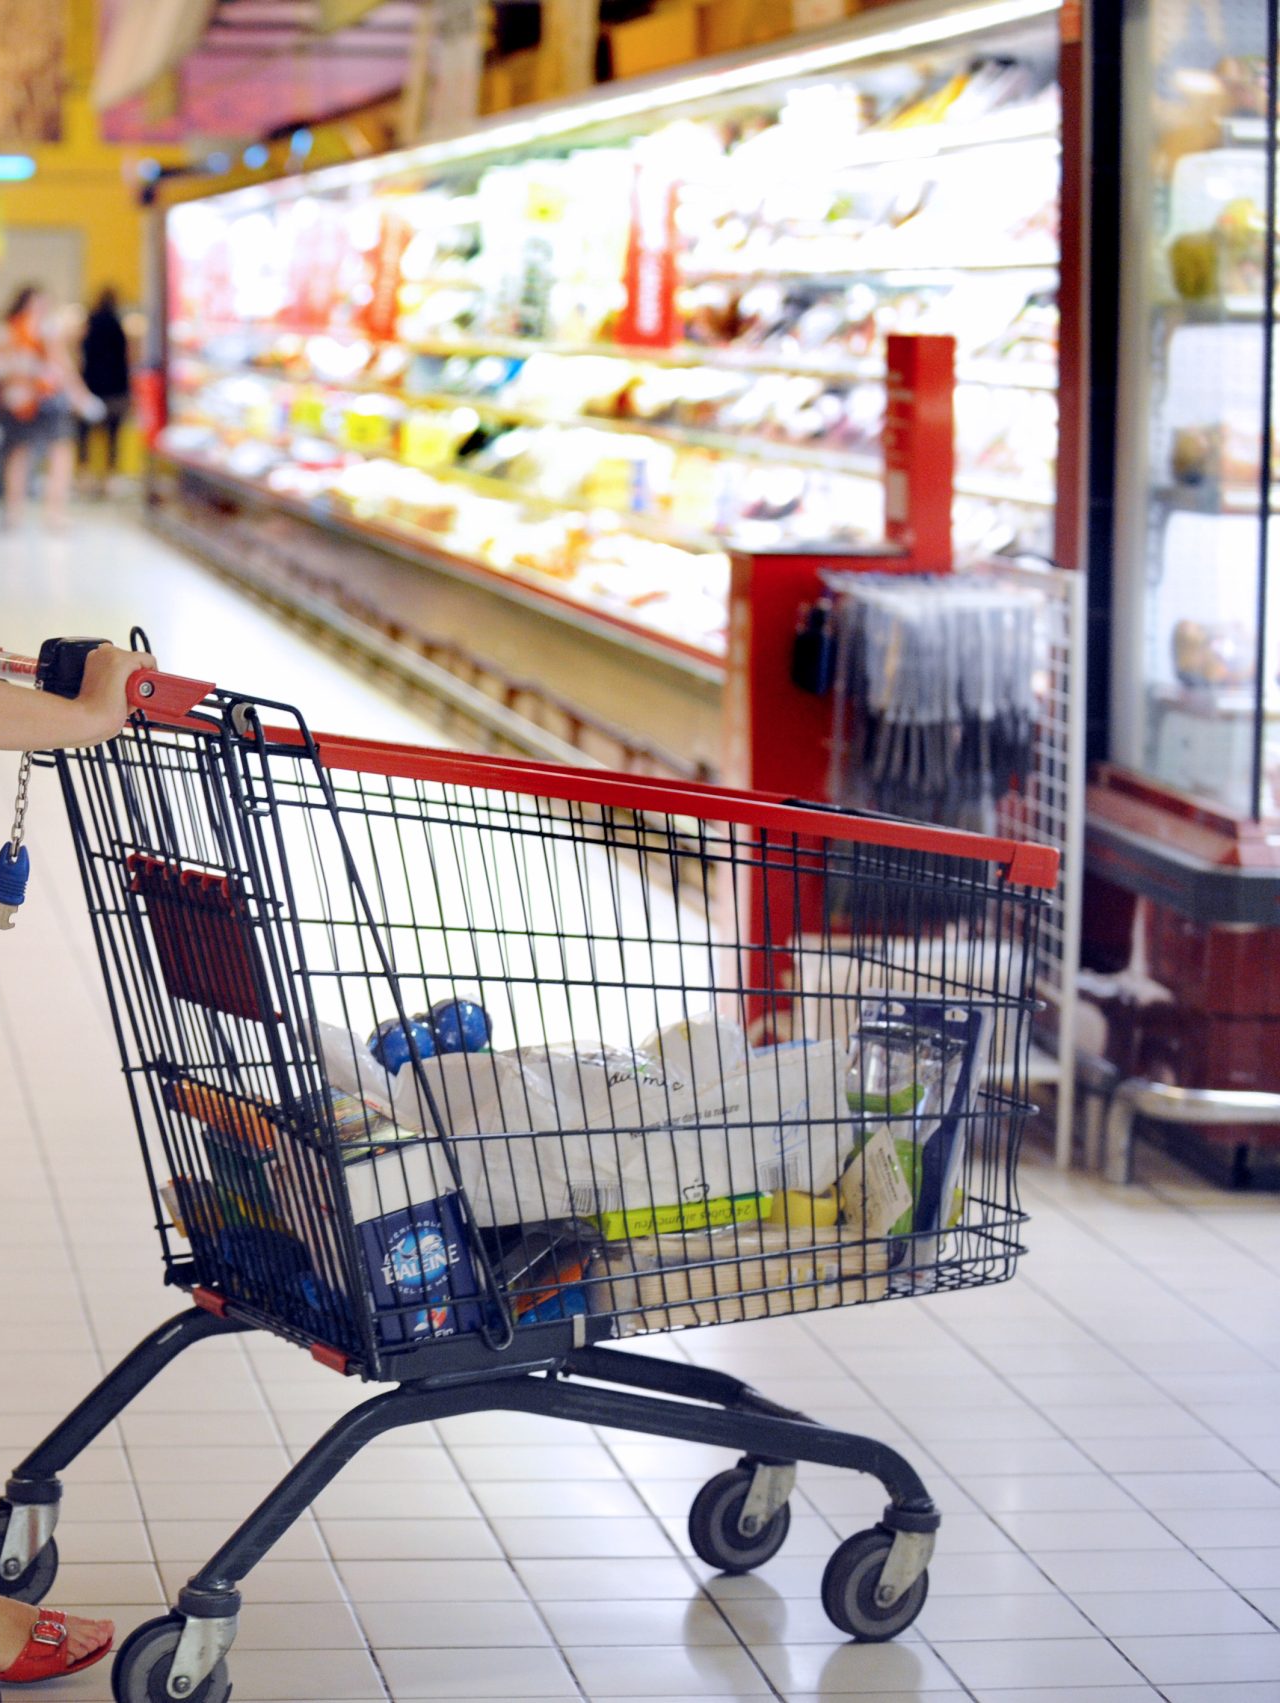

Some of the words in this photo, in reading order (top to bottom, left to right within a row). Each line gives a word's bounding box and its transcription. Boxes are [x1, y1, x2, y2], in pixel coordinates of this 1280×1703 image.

[713, 1103, 740, 1117] naure
[700, 1207, 732, 1221] Cubs
[380, 1243, 460, 1285] BALEINE
